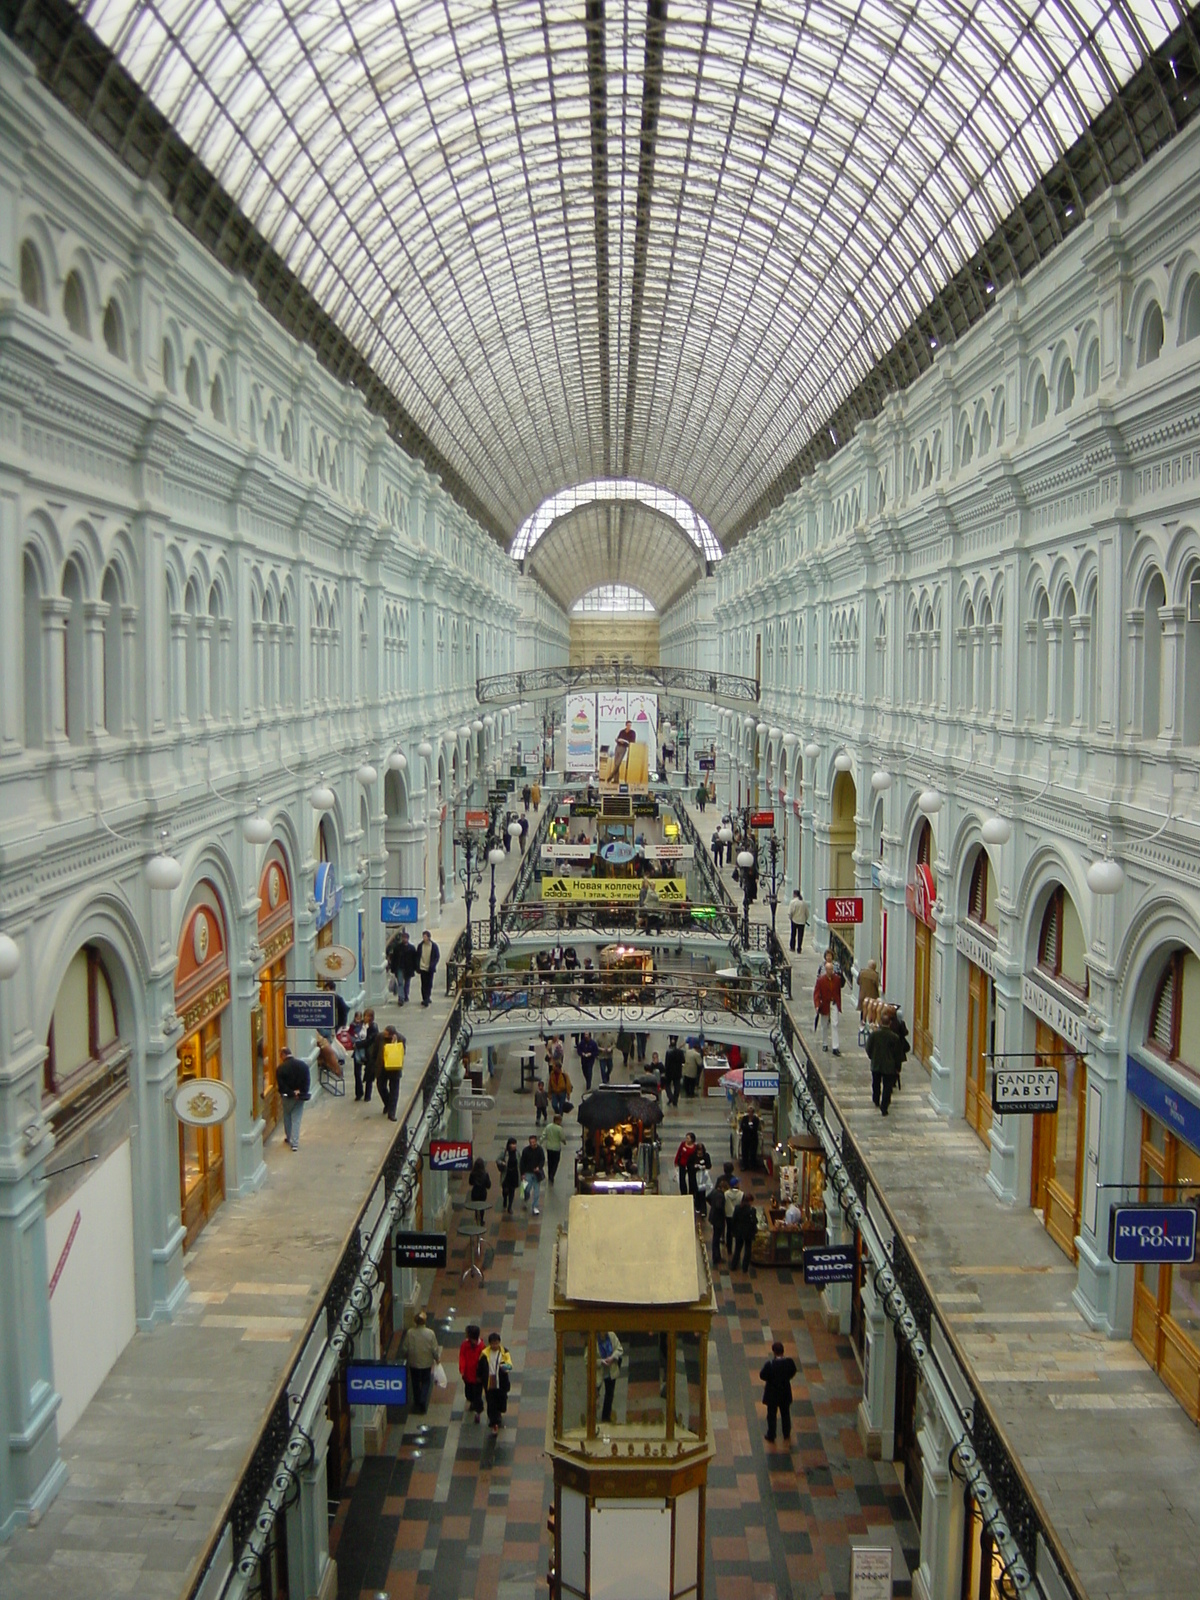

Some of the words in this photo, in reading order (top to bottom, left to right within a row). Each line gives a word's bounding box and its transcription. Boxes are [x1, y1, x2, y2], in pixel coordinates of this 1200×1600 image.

[573, 880, 602, 890] Новая
[605, 883, 641, 891] коллекц
[544, 890, 572, 898] adidas
[659, 891, 683, 899] didas
[287, 1000, 332, 1008] PIONEER
[1024, 982, 1054, 1021] SANDRA
[998, 1074, 1055, 1085] SANDRA
[1002, 1085, 1051, 1097] PABST
[1119, 1225, 1163, 1237] RICO
[1140, 1235, 1190, 1247] PONTI
[405, 1251, 438, 1259] ТОВАРЫ
[812, 1254, 847, 1262] TOM
[806, 1263, 853, 1272] TAILOR
[350, 1379, 403, 1390] CASIO
